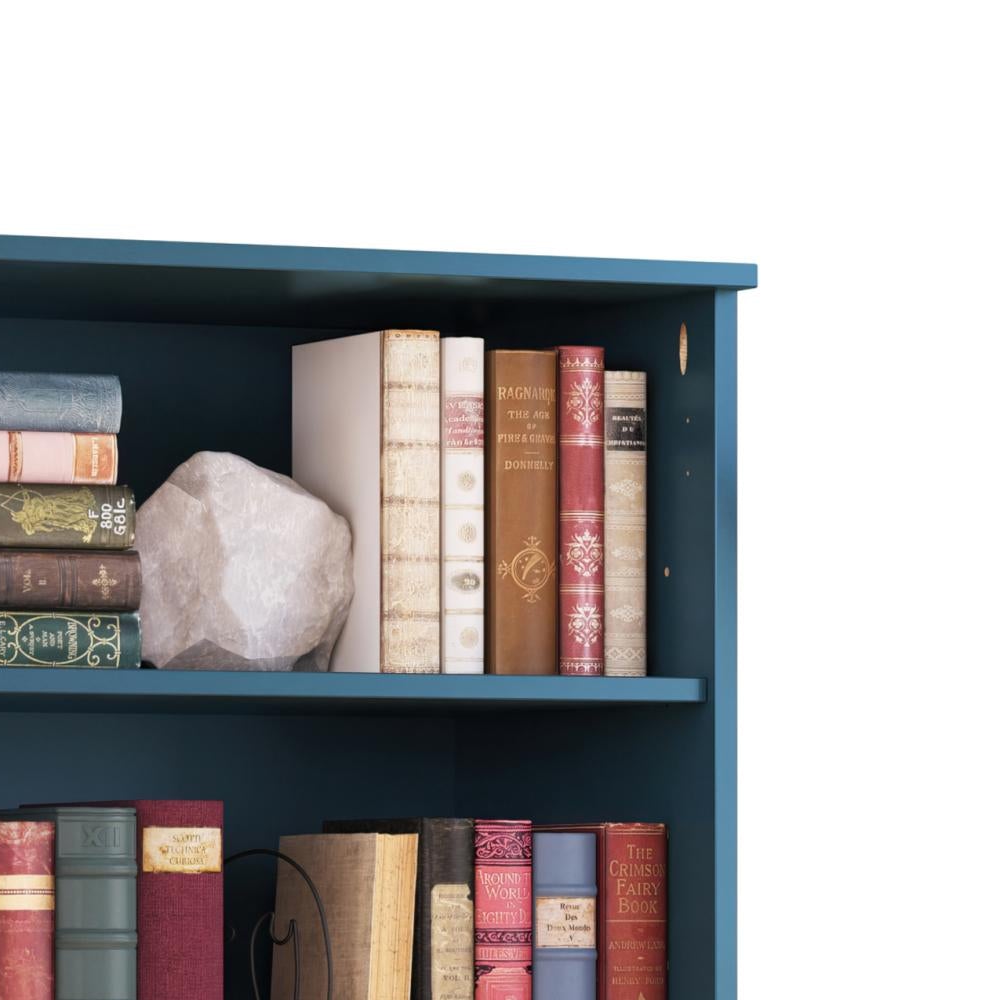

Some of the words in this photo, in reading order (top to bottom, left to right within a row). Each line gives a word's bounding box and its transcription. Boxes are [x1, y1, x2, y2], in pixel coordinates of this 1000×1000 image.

[507, 410, 529, 419] THE
[533, 410, 550, 419] AGE
[504, 460, 554, 470] DONNELLY
[88, 510, 99, 519] F
[100, 503, 112, 529] 800
[627, 844, 653, 860] THE
[609, 860, 666, 877] CRIMSON
[616, 879, 661, 896] FAIRY
[618, 897, 658, 914] BOOK
[565, 913, 578, 921] Des
[608, 940, 646, 950] ANDREW
